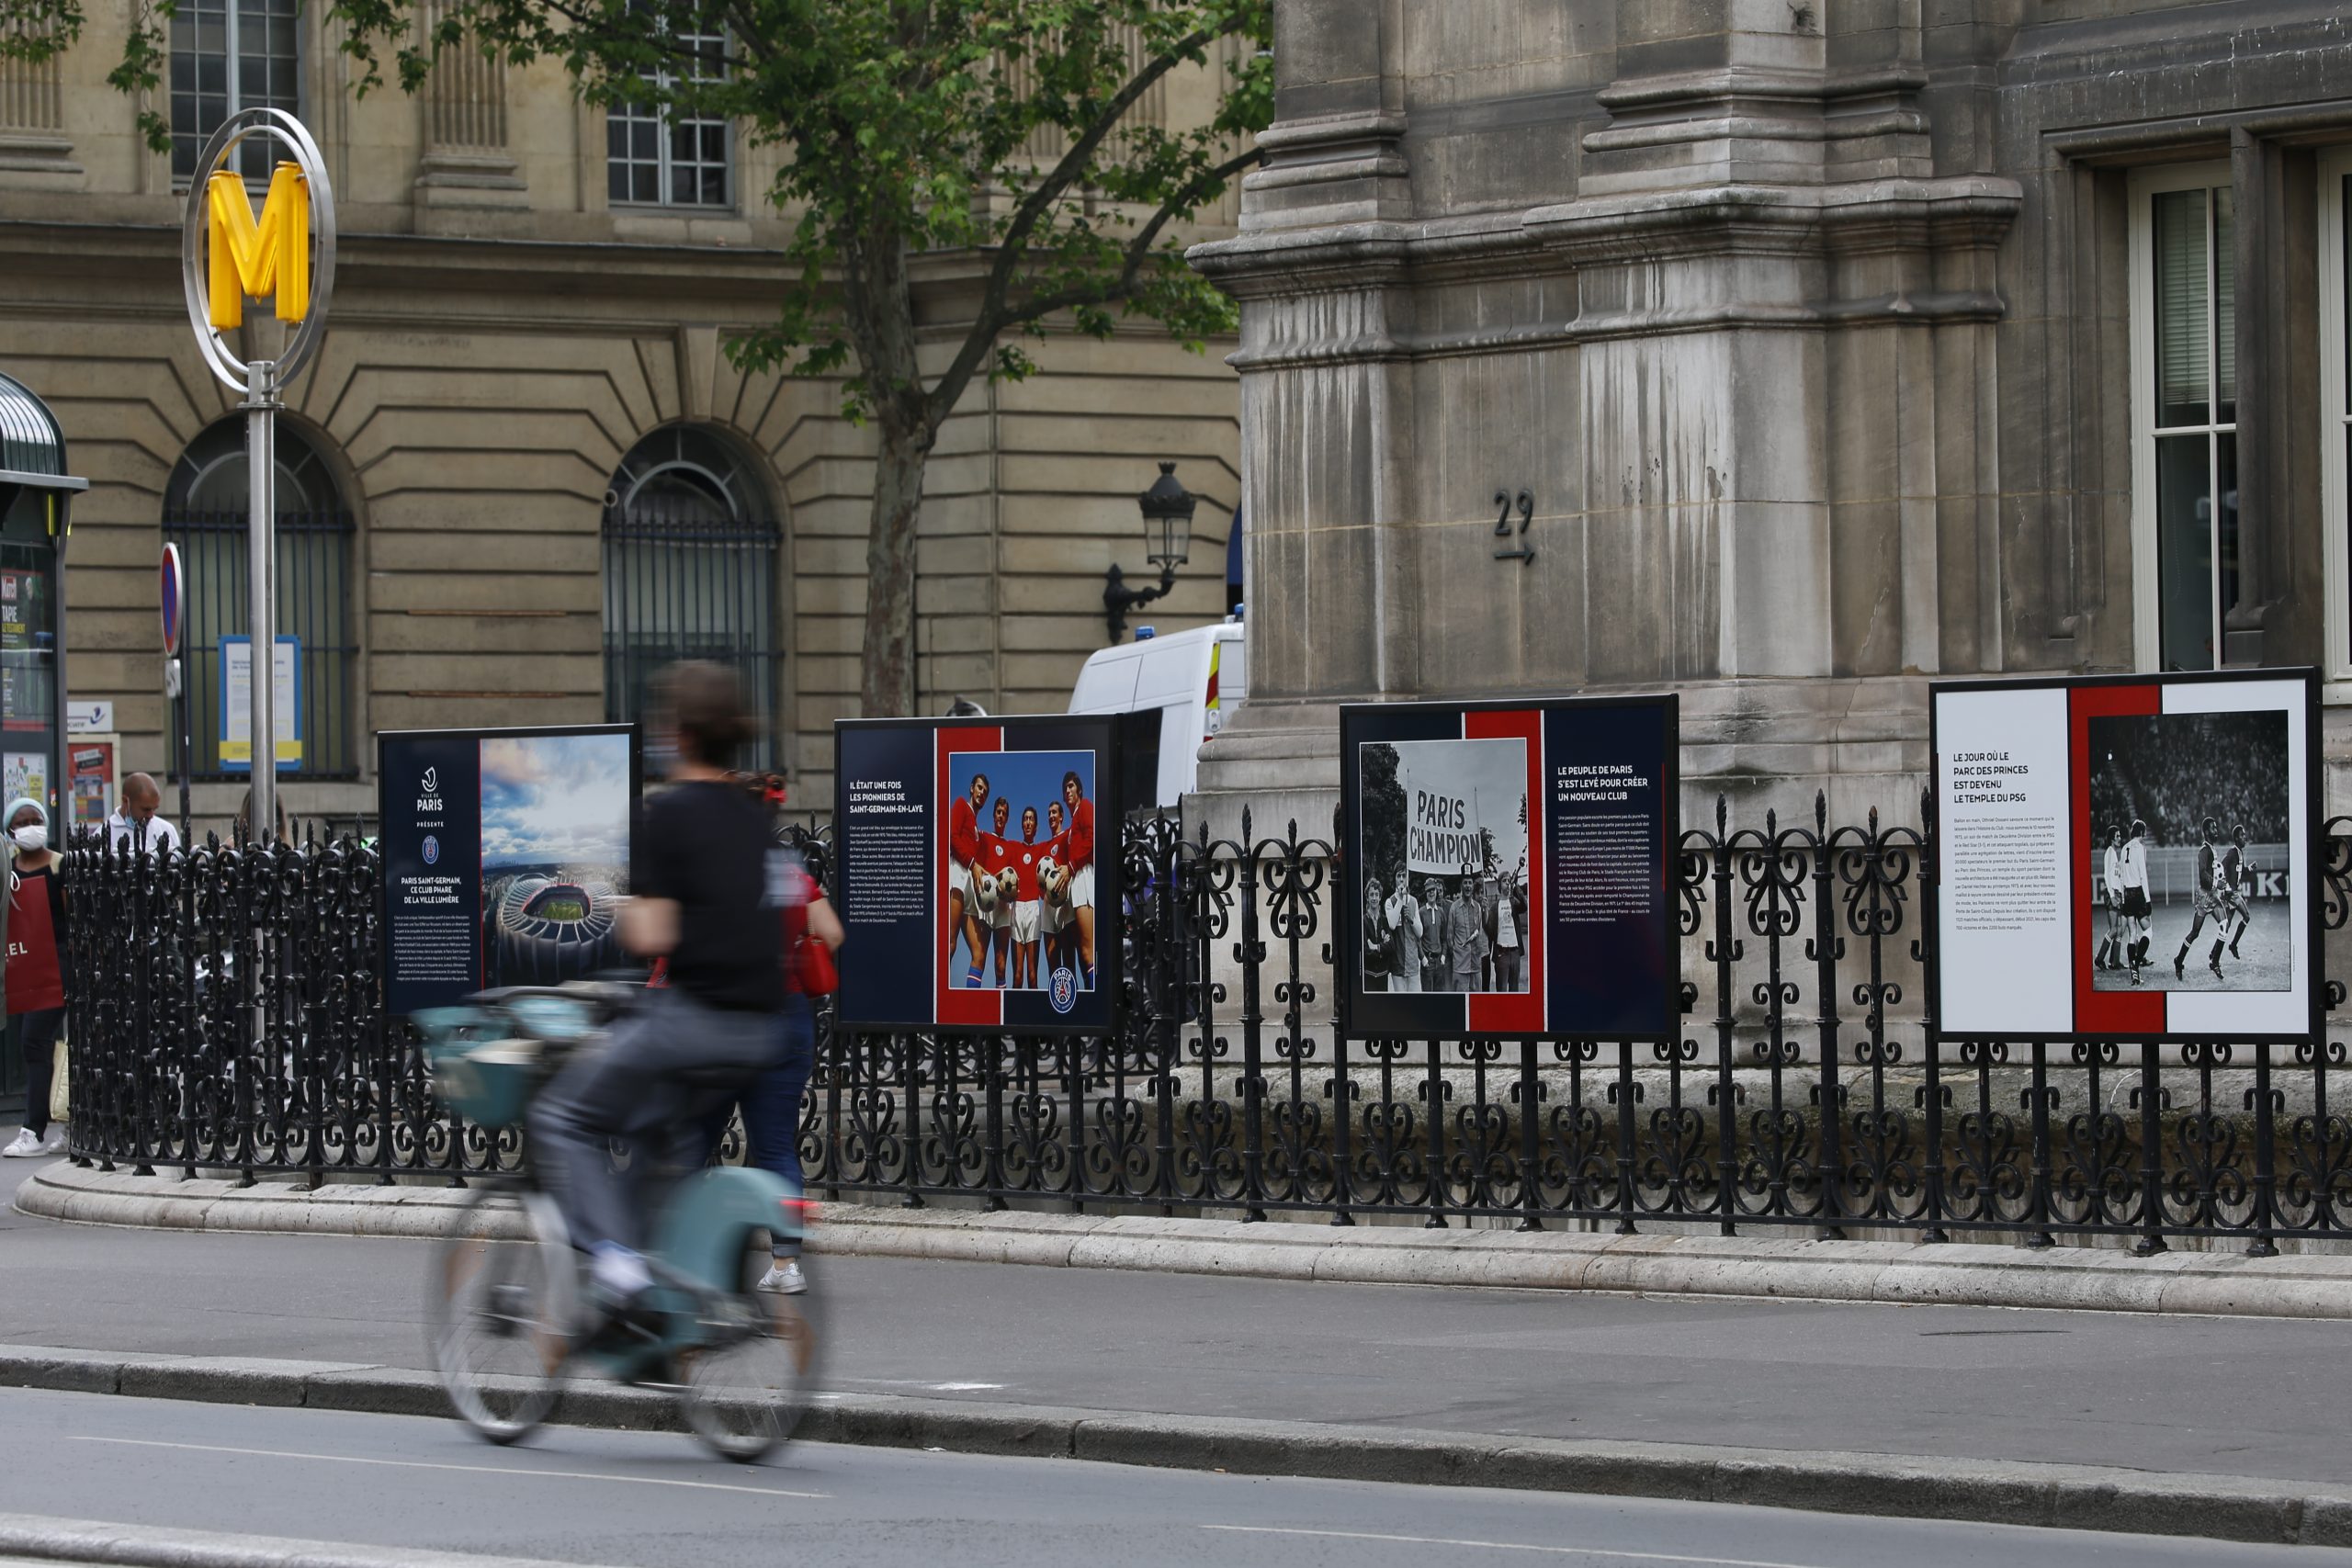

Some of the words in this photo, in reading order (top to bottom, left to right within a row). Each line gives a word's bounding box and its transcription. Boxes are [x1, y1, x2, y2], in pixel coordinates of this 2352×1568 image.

[208, 161, 309, 331] M
[1494, 488, 1534, 537] 29
[1964, 753, 1985, 761] JOUR
[1987, 750, 1998, 761] OÙ
[1568, 766, 1597, 775] PEUPLE
[1610, 765, 1632, 773] PARIS
[1954, 767, 1974, 775] PARC
[1977, 767, 1992, 775] DES
[1994, 766, 2028, 774] PRINCES
[857, 780, 874, 789] ÉTAIT
[1580, 777, 1598, 787] LEVÉ
[1623, 776, 1647, 786] CRÉER
[1571, 793, 1606, 801] NOUVEAU
[1608, 792, 1627, 800] CLUB
[1997, 794, 2008, 802] DU
[418, 799, 442, 811] PARIS
[850, 805, 923, 813] SAINT-GERMAIN-EN-LAYE
[1418, 790, 1465, 830] PARIS
[1410, 825, 1481, 865] CHAMPION
[2125, 848, 2130, 863] 1
[435, 895, 458, 903] LUMIÈRE
[1054, 970, 1072, 981] PARIS
